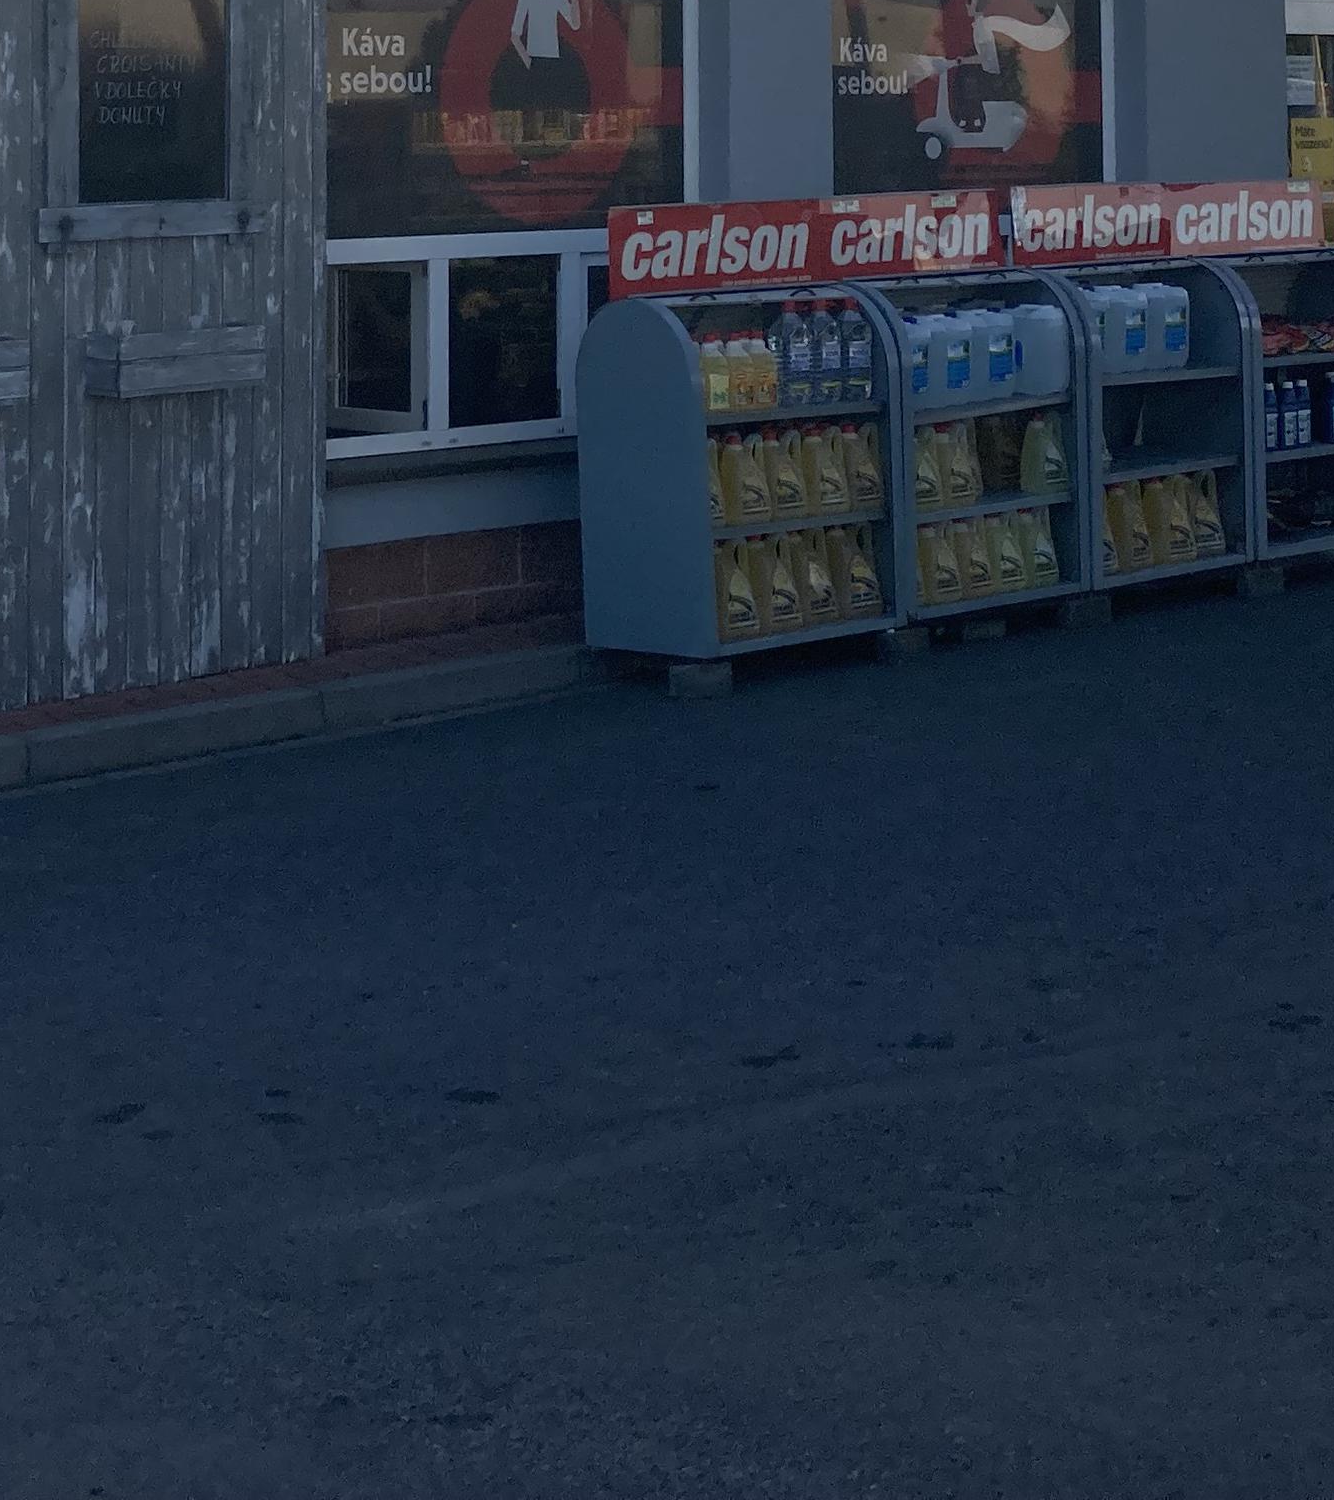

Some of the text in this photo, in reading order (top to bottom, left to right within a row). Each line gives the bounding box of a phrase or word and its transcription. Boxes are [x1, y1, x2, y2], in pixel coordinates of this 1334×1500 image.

[342, 27, 405, 56] Káva
[839, 37, 887, 63] Káva
[340, 65, 432, 94] sebou!
[838, 70, 909, 96] sebou!
[621, 190, 1314, 281] carlson carlson carlson carlson
